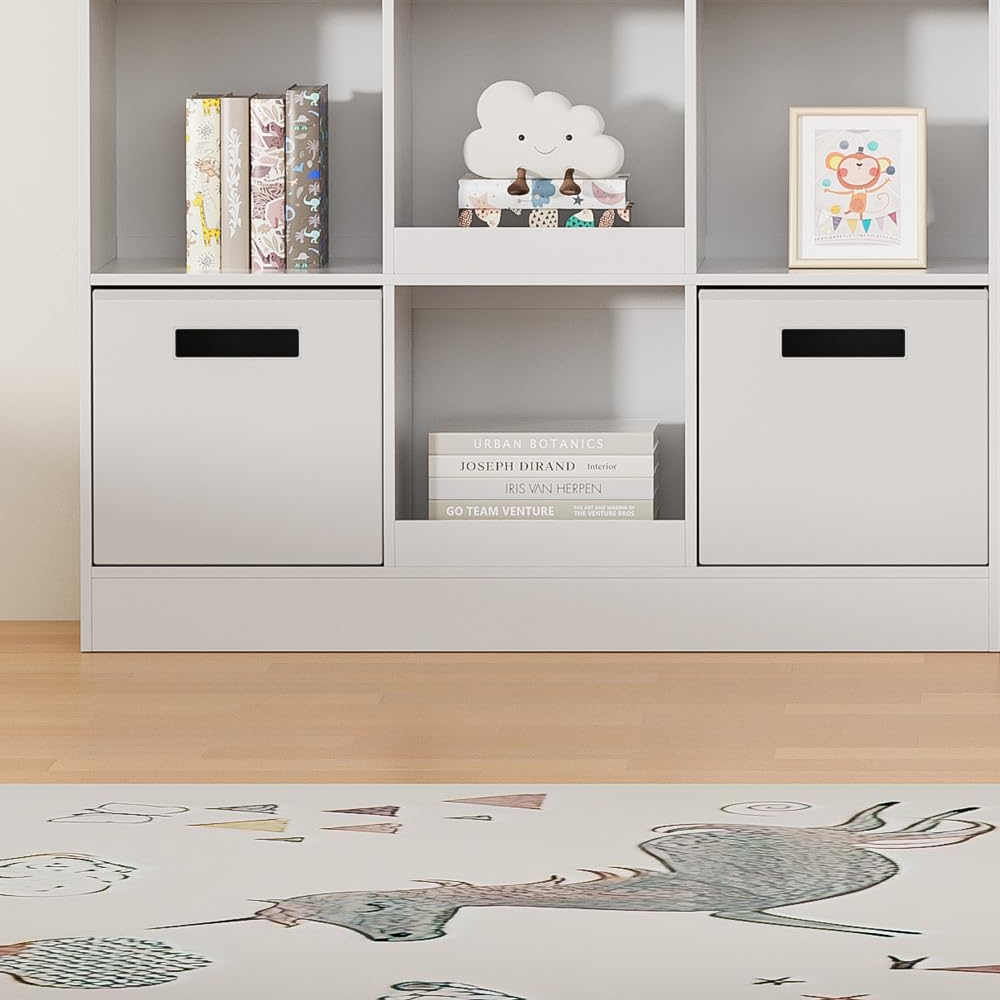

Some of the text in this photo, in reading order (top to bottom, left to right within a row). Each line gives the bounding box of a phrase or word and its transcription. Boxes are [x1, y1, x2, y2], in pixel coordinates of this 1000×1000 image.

[474, 439, 604, 449] URBAN BOTANICS
[460, 462, 513, 472] JOSEPH
[520, 462, 576, 472] DIRAND
[506, 483, 602, 494] IRIS VAN HERPEN
[446, 506, 554, 516] GO TEAM VENTURE
